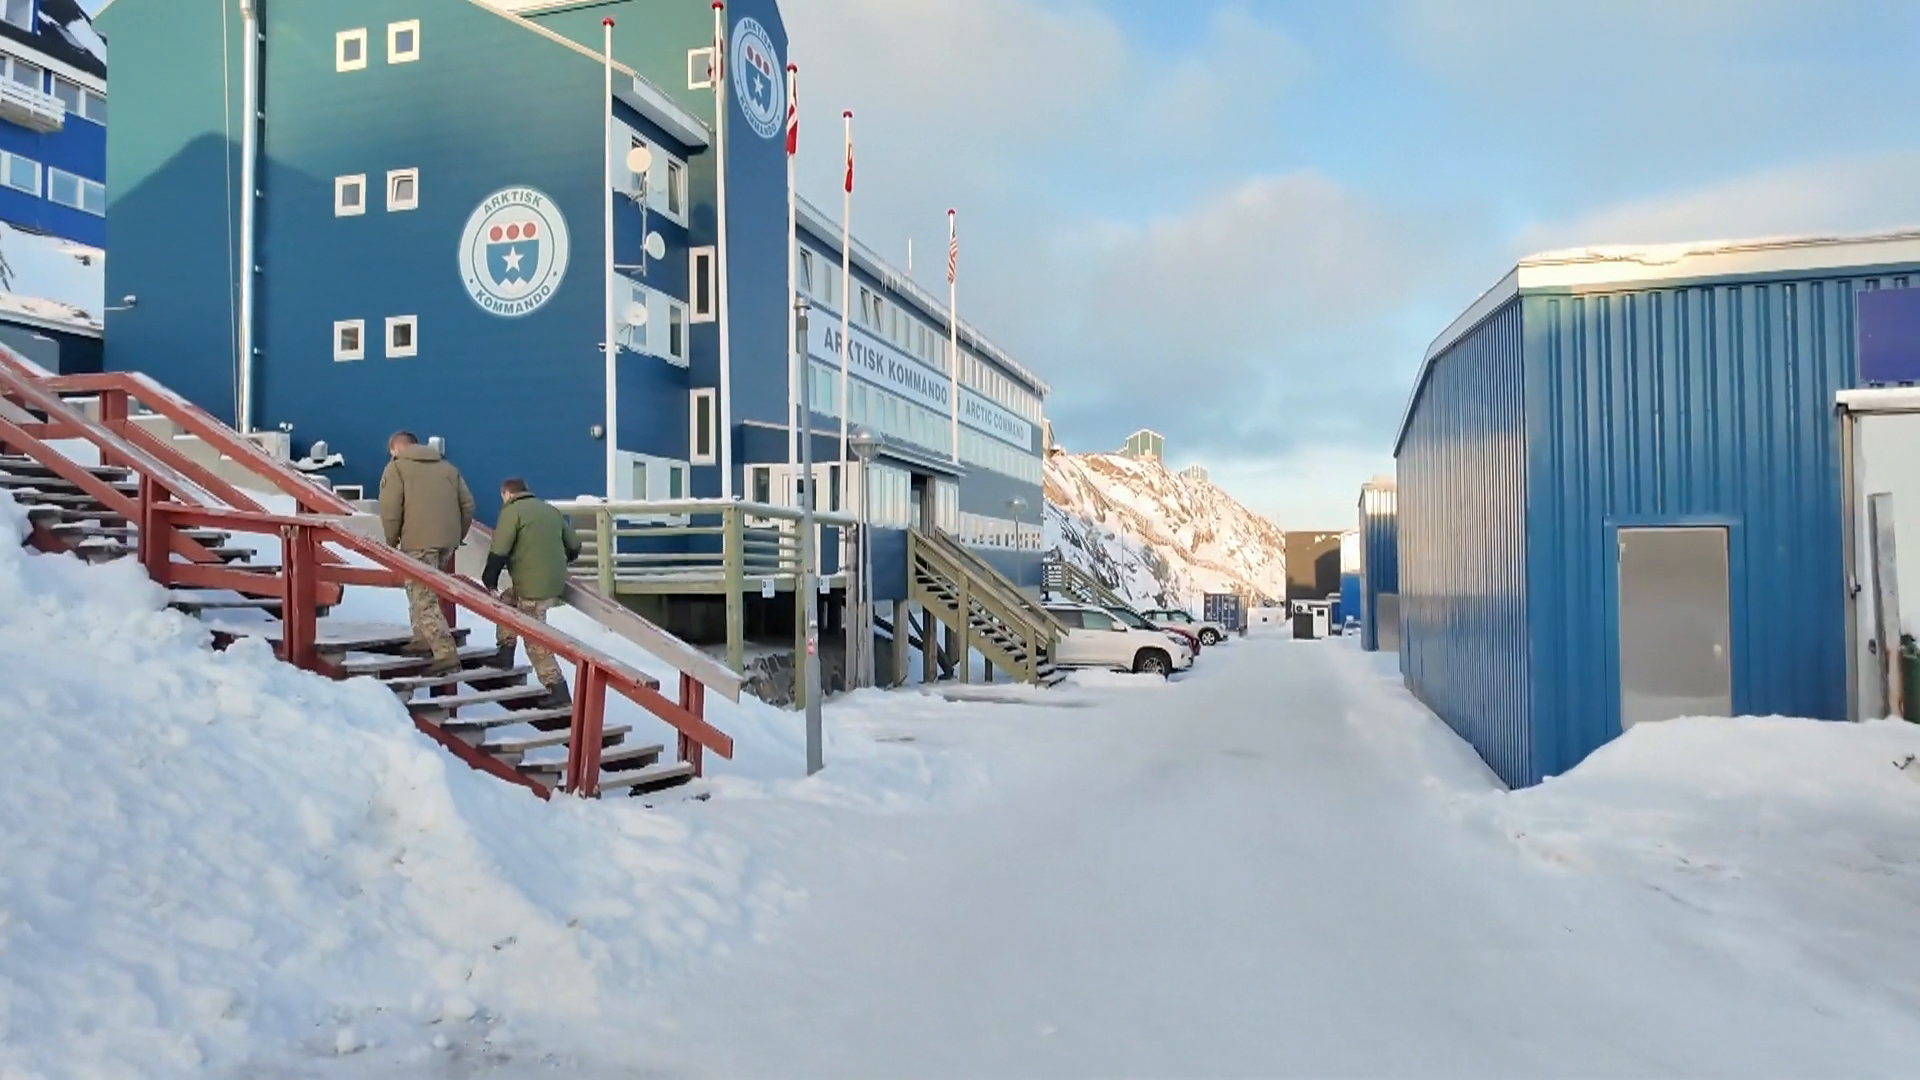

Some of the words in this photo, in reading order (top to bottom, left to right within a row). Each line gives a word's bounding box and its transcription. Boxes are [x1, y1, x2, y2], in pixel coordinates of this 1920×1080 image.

[483, 190, 543, 215] ARKTISK
[475, 284, 551, 314] KOMMANDO
[888, 358, 947, 405] KOMMANDO
[965, 398, 992, 425] ARCTIC
